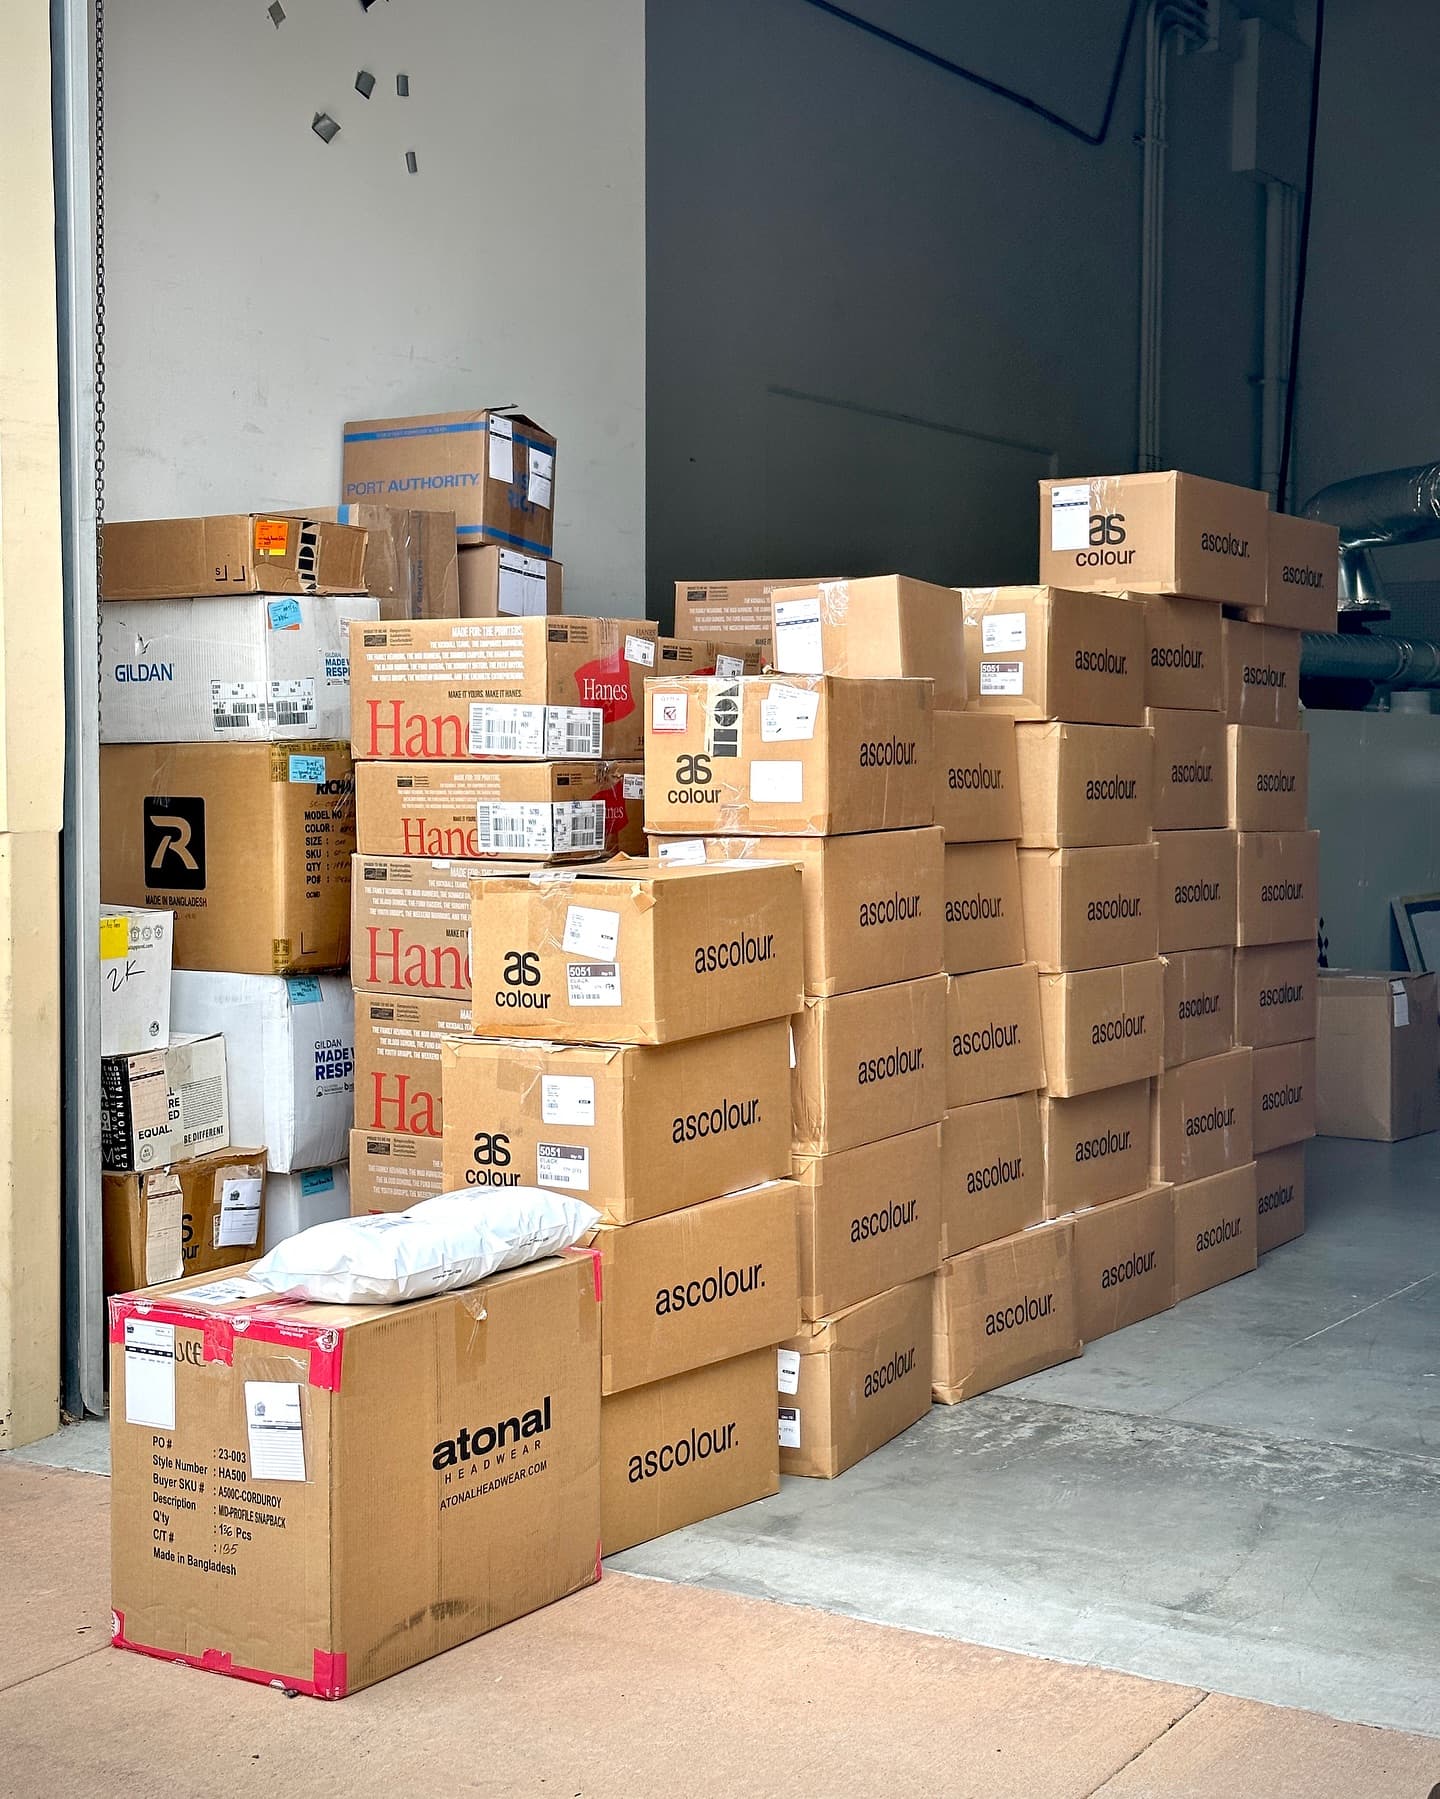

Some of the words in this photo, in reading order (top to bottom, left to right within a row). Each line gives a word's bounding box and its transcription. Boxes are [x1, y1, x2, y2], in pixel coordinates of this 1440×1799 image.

[347, 481, 384, 496] PORT
[388, 473, 479, 492] AUTHORITY
[1202, 533, 1249, 558] ascolour.
[1076, 550, 1136, 566] colour
[1283, 566, 1324, 588] ascolour.
[326, 658, 346, 666] MADE
[1075, 648, 1127, 674] ascolour.
[1151, 644, 1204, 668] ascolour.
[115, 664, 172, 682] GILDAN
[326, 666, 350, 677] RESP
[1244, 665, 1286, 688] ascolour.
[448, 690, 462, 699] MAKE
[485, 690, 499, 698] MAKE
[583, 678, 628, 700] Hanes
[860, 736, 916, 767] ascolour.
[949, 763, 1003, 789] ascolour.
[1172, 761, 1213, 783] ascolour.
[1257, 770, 1295, 792] ascolour.
[668, 788, 722, 804] colour
[1087, 775, 1136, 800] ascolour.
[304, 810, 330, 820] MODEL
[605, 806, 624, 819] nes
[306, 837, 322, 846] SIZE
[306, 850, 322, 859] SKU
[306, 862, 322, 872] QTY
[450, 867, 467, 878] MADE
[146, 896, 162, 906] MADE
[162, 896, 168, 906] IN
[169, 896, 208, 908] BANGLADESH
[1175, 880, 1220, 904] ascolour.
[1262, 880, 1303, 902] ascolour.
[860, 891, 921, 927] ascolour.
[945, 893, 1003, 922] ascolour.
[1088, 894, 1141, 921] ascolour.
[446, 929, 459, 937] MAKE
[695, 932, 775, 973] ascolour.
[504, 952, 540, 986] as
[569, 967, 591, 977] 5051
[496, 989, 550, 1009] colour
[1179, 992, 1220, 1019] ascolour.
[1260, 983, 1303, 1007] ascolour.
[953, 1022, 1020, 1056] ascolour.
[1092, 1013, 1146, 1044] ascolour.
[315, 1039, 342, 1049] GILDAN
[315, 1048, 349, 1063] MADE
[316, 1060, 354, 1080] RESP
[859, 1047, 924, 1084] ascolour.
[167, 1087, 174, 1096] L
[1263, 1085, 1302, 1111] ascolour.
[370, 1072, 442, 1136] Ha
[116, 1085, 128, 1168] CALIFORNIA
[138, 1125, 172, 1140] EQUAL.
[673, 1099, 761, 1143] ascolour.
[1187, 1107, 1235, 1136] ascolour.
[184, 1134, 191, 1144] BE
[192, 1125, 224, 1141] DIFFERENT
[1076, 1130, 1131, 1162] ascolour.
[474, 1132, 512, 1166] as
[540, 1146, 560, 1157] 5051
[466, 1168, 520, 1187] colour
[967, 1158, 1024, 1194] ascolour.
[1258, 1185, 1294, 1215] ascolour.
[182, 1214, 194, 1242] s
[851, 1200, 918, 1242] ascolour.
[1197, 1218, 1242, 1252] ascolour.
[1102, 1251, 1156, 1288] ascolour.
[656, 1264, 765, 1315] ascolour.
[986, 1294, 1055, 1335] ascolour.
[865, 1347, 915, 1398] ascolour.
[153, 1436, 165, 1448] PO
[167, 1440, 172, 1449] #
[432, 1396, 551, 1471] atonal
[218, 1448, 246, 1463] 23-003
[444, 1440, 541, 1485] HEADWEAR
[629, 1423, 738, 1483] ascolour.
[153, 1455, 173, 1468] Style
[175, 1459, 208, 1475] Number
[218, 1467, 246, 1482] HA500
[153, 1473, 177, 1488] Buyer
[179, 1478, 197, 1492] SKU
[199, 1482, 204, 1493] #
[439, 1460, 548, 1511] ATONALHEADWEAR.COM
[153, 1492, 196, 1510] Description
[218, 1486, 281, 1508] A500C-CORDUROY
[153, 1510, 170, 1526] Q'ty
[218, 1505, 253, 1522] MID-PROFILE
[255, 1511, 286, 1528] SNAPBACK
[153, 1529, 167, 1540] C/T
[169, 1532, 174, 1542] #
[236, 1527, 252, 1540] Pcs
[153, 1546, 175, 1562] Made
[178, 1552, 185, 1564] in
[188, 1554, 237, 1576] Bangladesh
